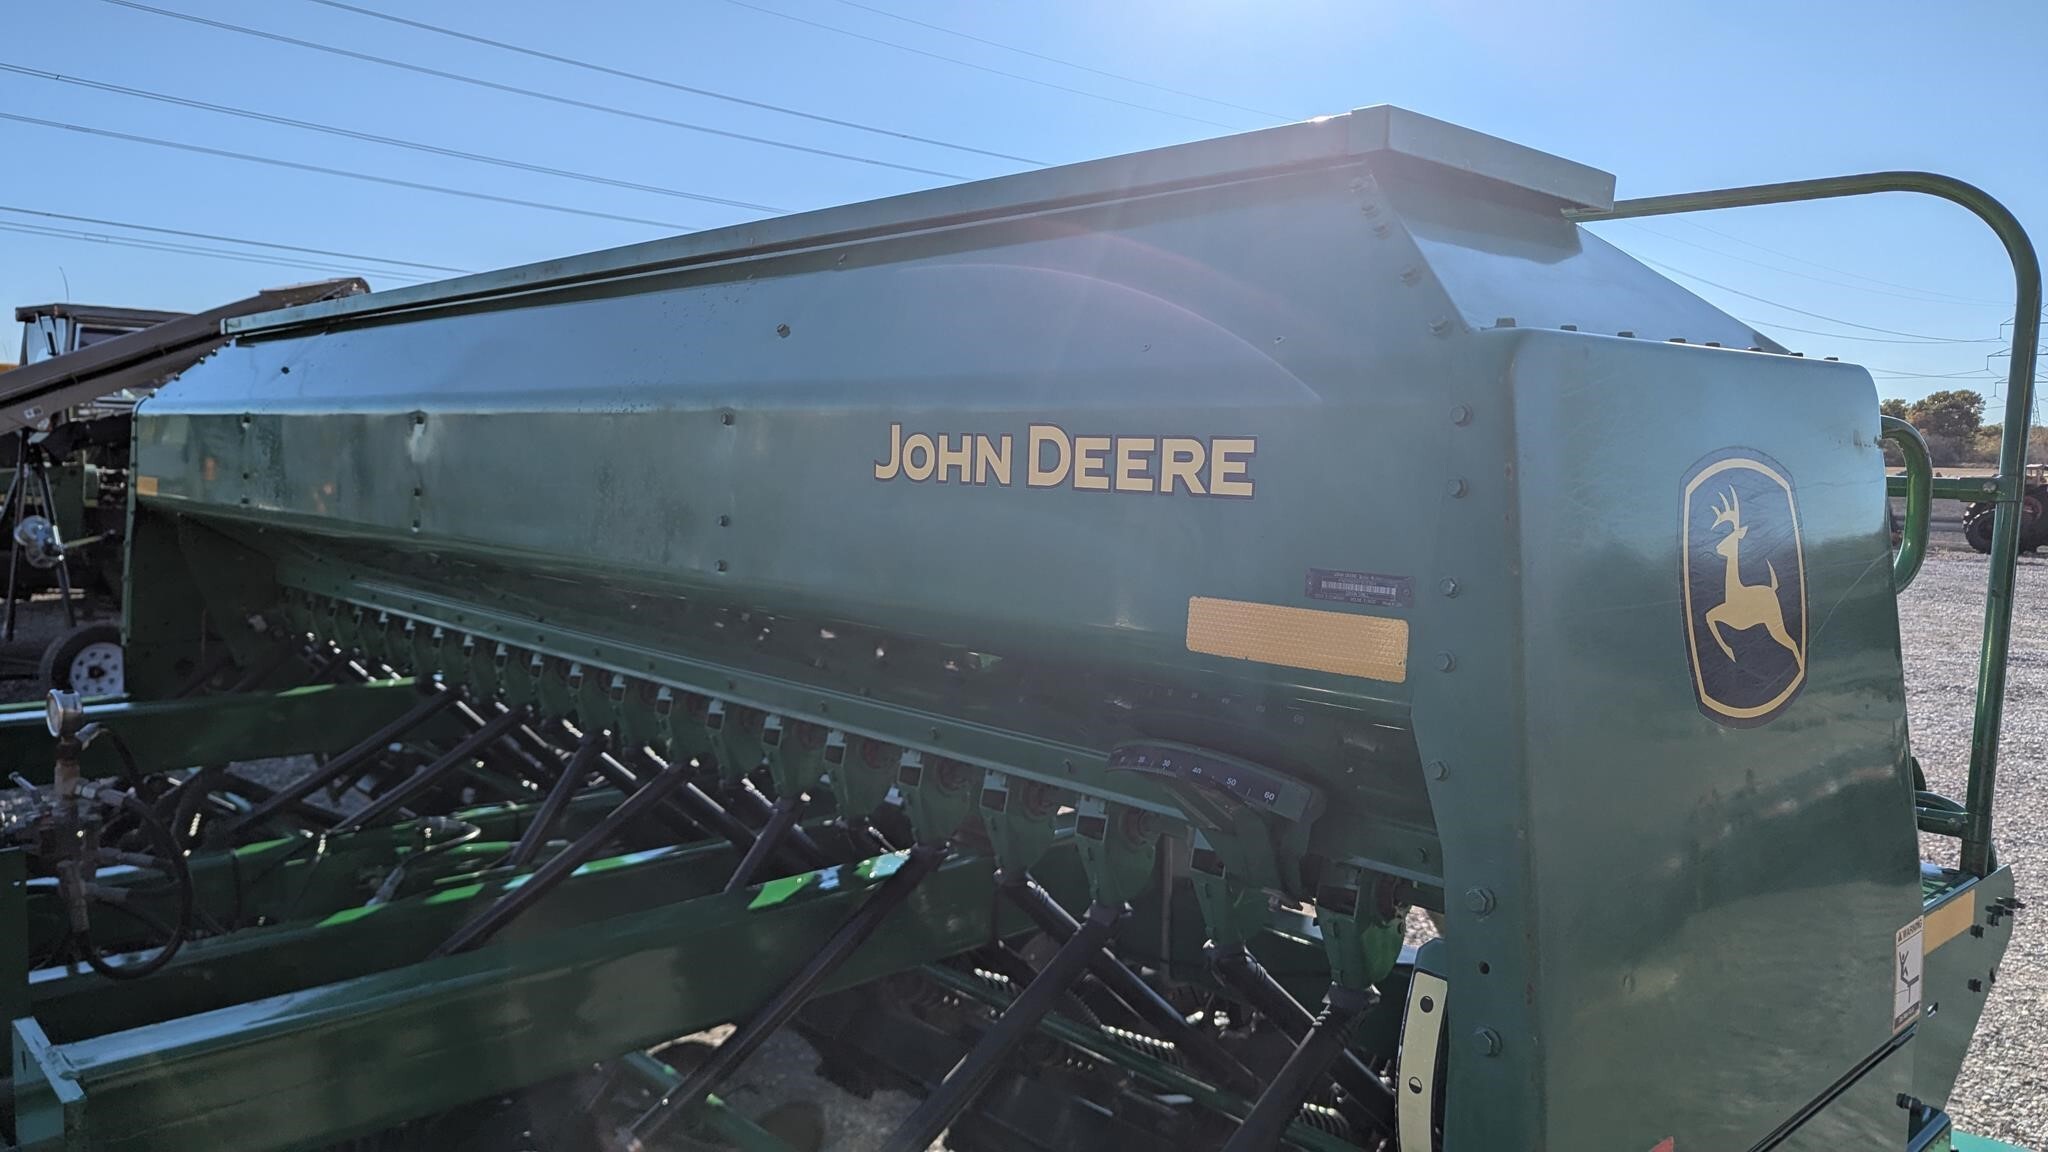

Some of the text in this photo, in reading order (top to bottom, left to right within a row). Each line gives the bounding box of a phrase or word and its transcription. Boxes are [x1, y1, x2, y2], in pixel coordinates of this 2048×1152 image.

[874, 423, 1257, 498] JOHN DEERE
[1226, 777, 1237, 786] 50
[1264, 791, 1275, 801] 60
